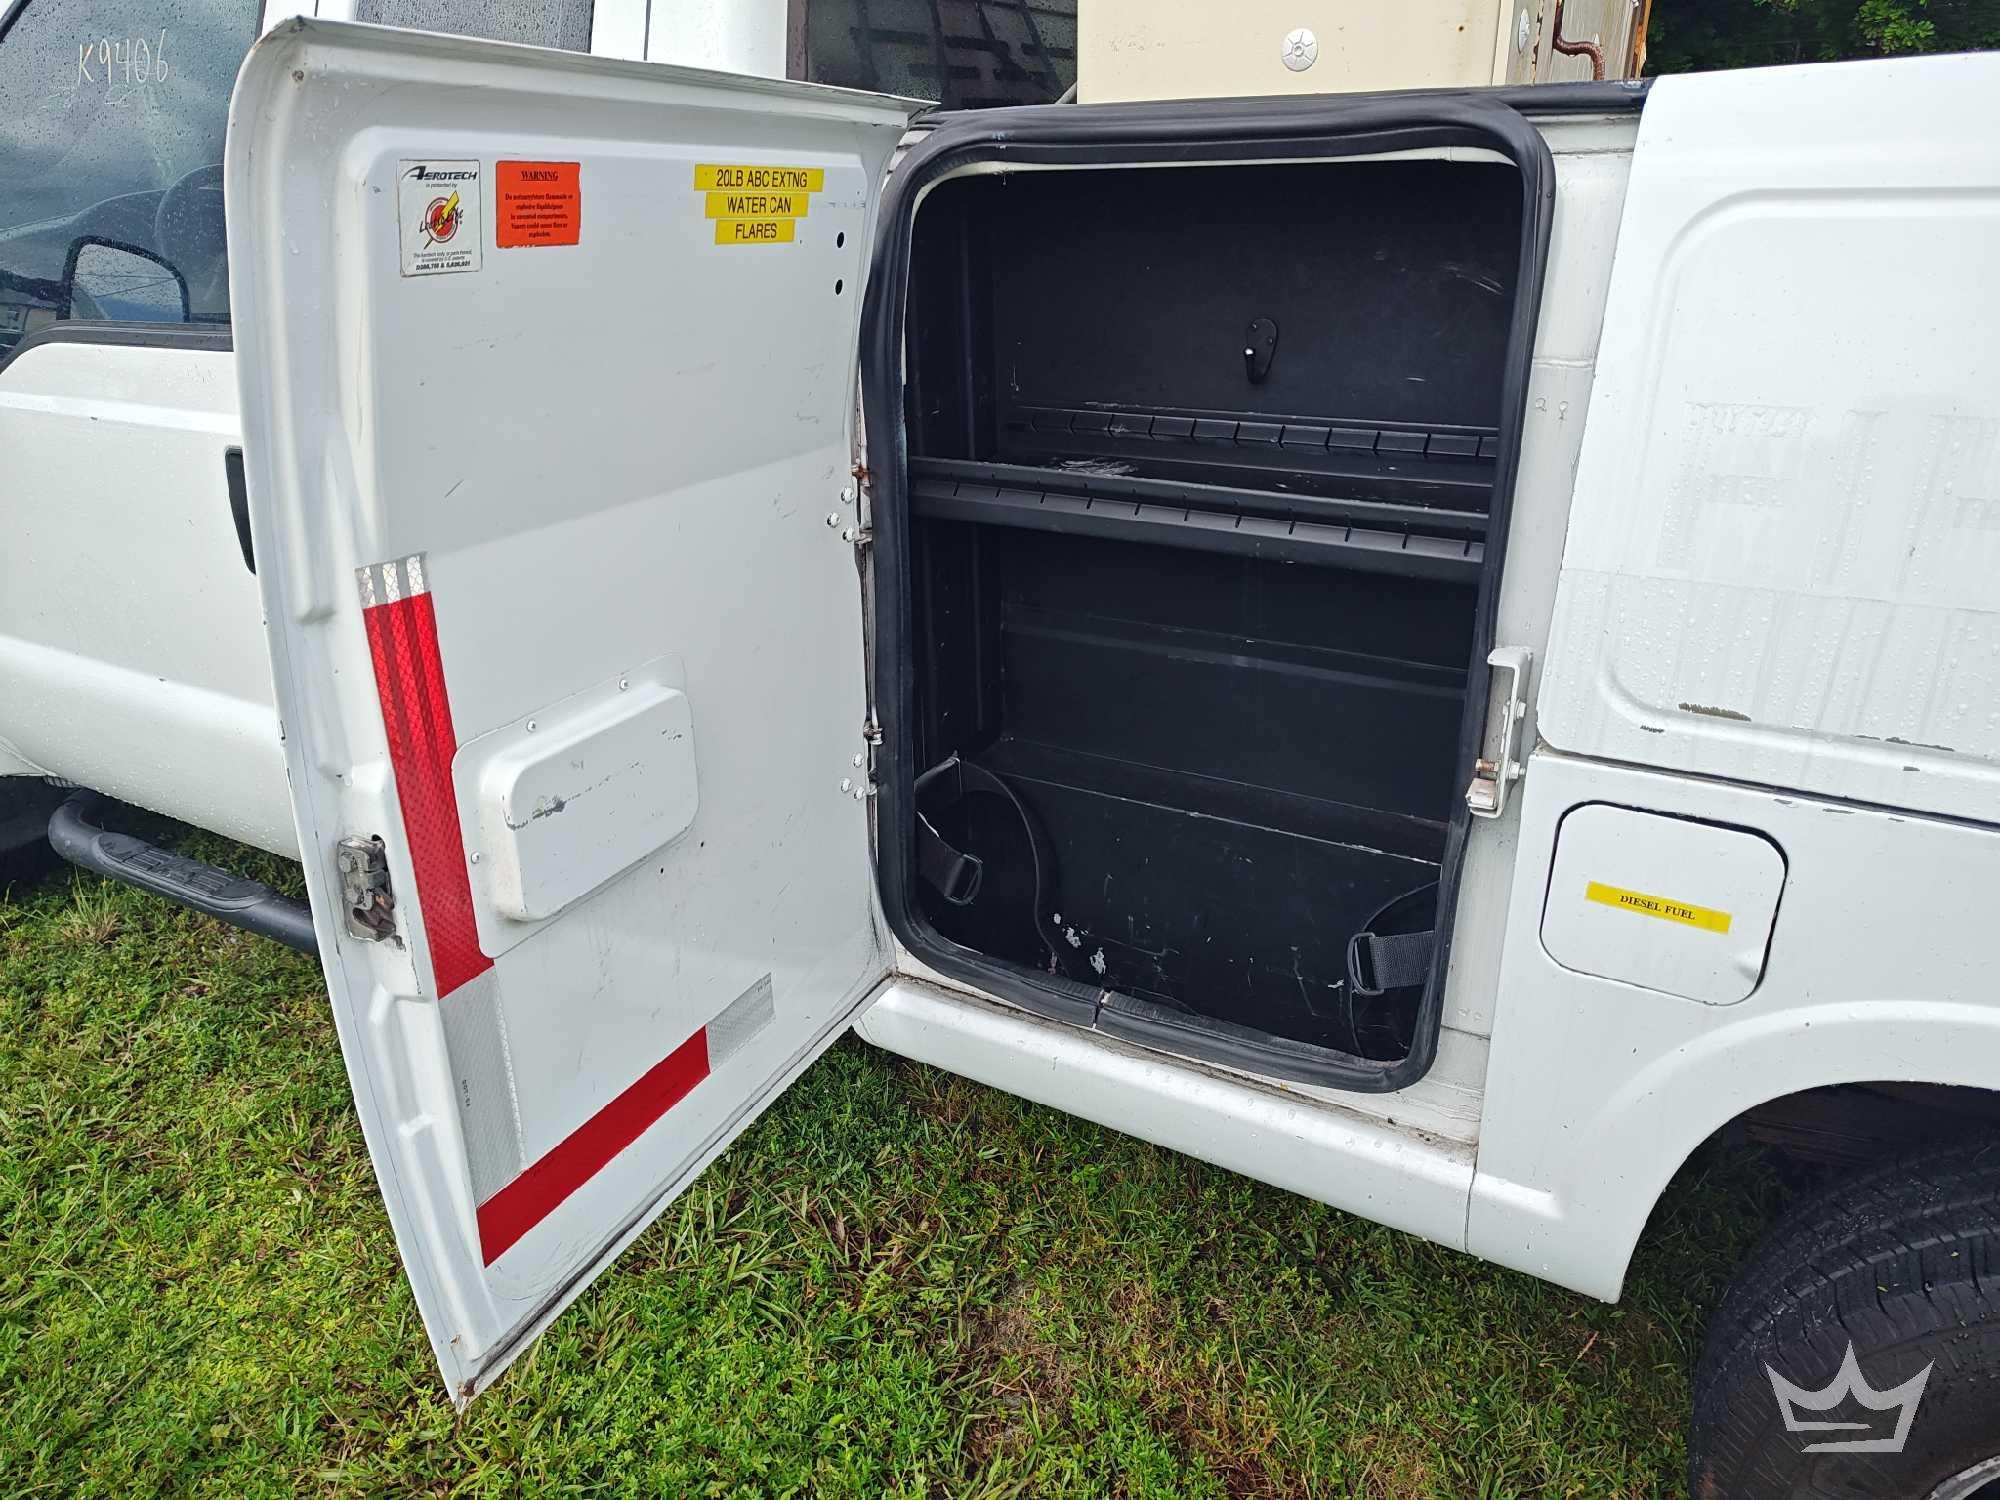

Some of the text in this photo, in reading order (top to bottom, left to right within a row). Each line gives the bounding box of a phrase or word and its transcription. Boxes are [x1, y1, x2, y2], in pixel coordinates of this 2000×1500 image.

[78, 29, 169, 86] K9406
[401, 165, 477, 180] AEROTECH
[520, 171, 559, 182] WARNING
[716, 169, 808, 188] 20LB ABC EXTNG
[728, 196, 792, 214] WATER CAN
[735, 223, 778, 239] FLARES
[1620, 894, 1696, 920] DIESEL FUEL
